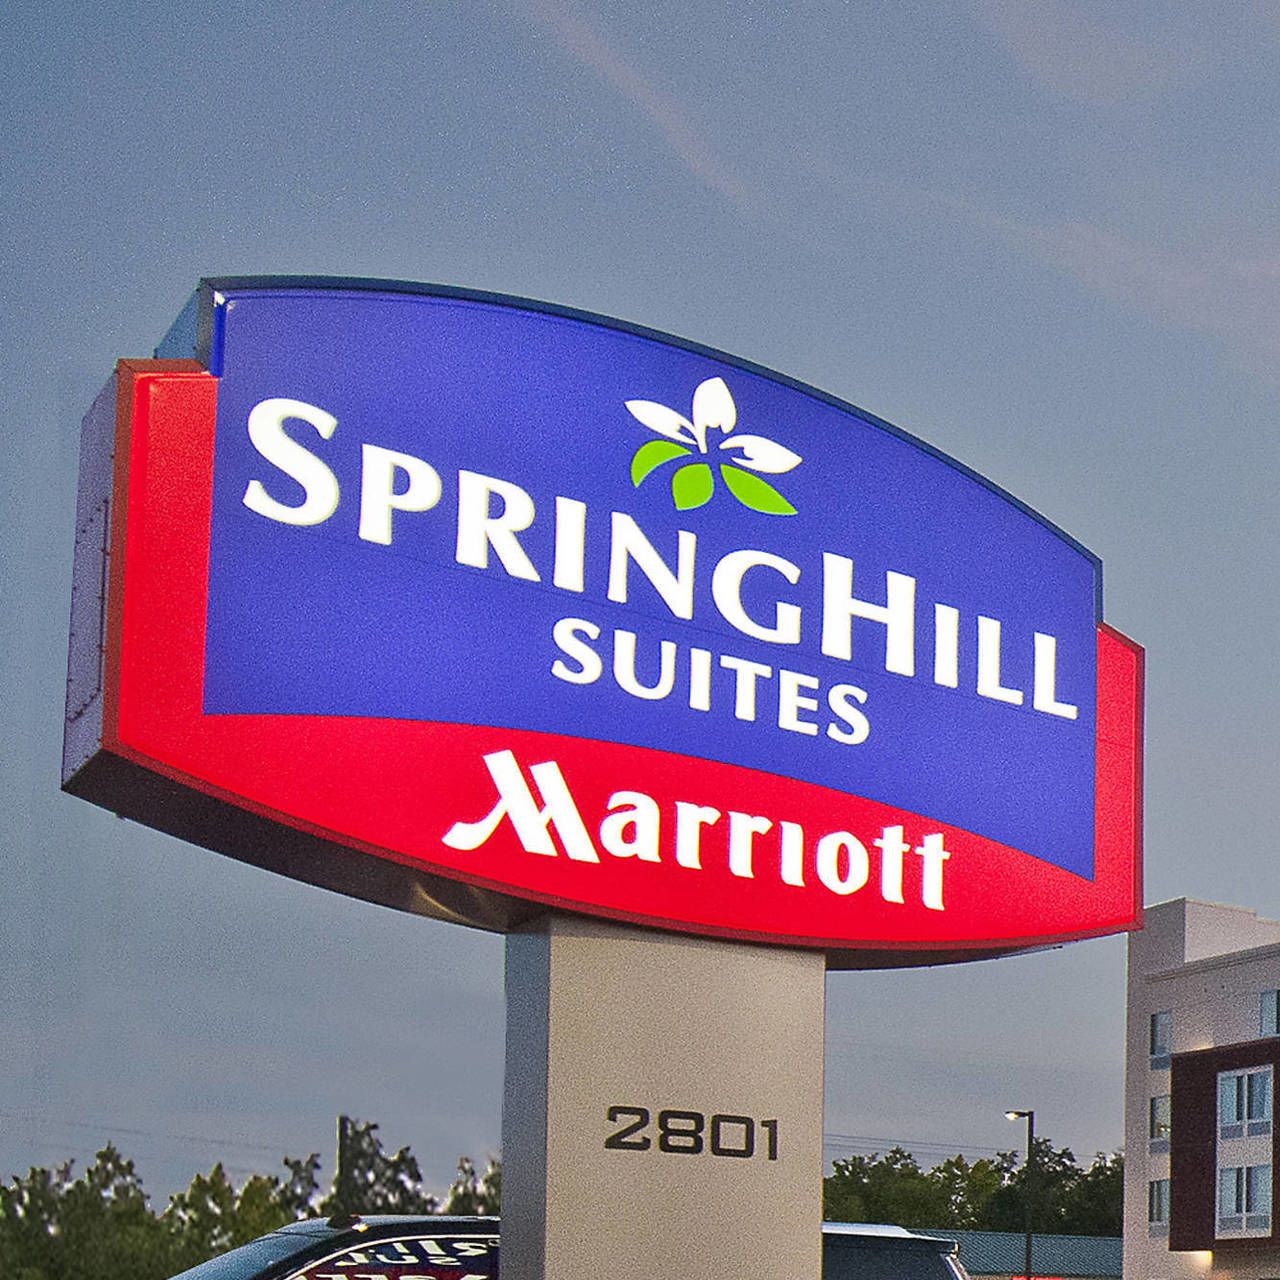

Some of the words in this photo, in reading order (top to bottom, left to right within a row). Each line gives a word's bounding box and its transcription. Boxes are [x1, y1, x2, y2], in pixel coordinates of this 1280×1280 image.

[551, 616, 871, 745] SUITES
[441, 748, 951, 912] Marriott
[605, 1106, 778, 1161] 2801
